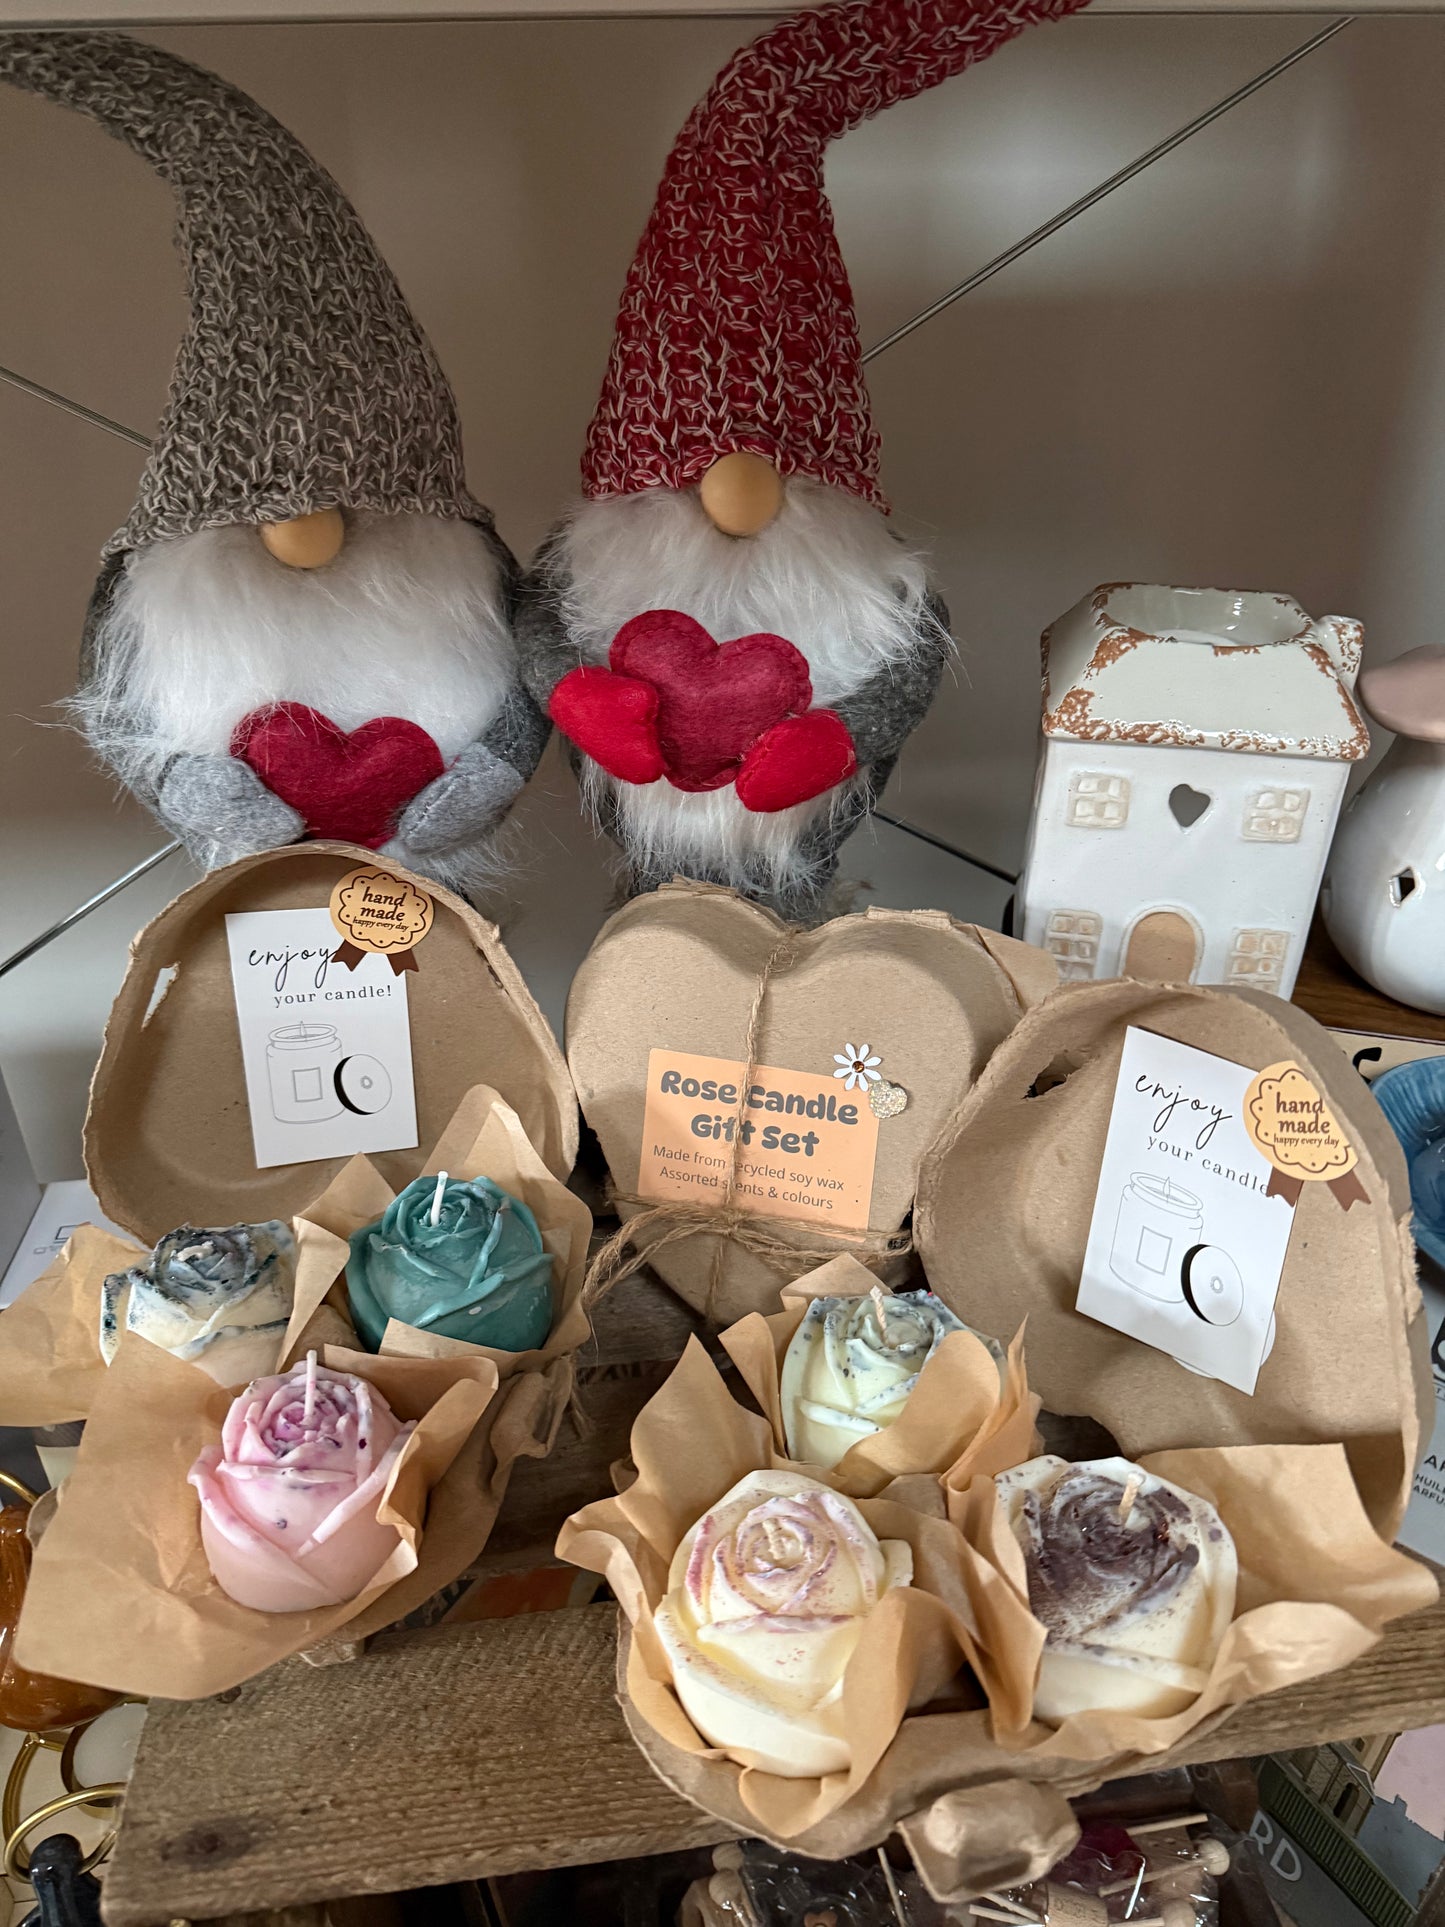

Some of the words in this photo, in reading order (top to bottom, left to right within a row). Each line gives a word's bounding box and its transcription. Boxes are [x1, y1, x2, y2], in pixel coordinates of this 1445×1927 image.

[360, 905, 406, 921] made
[362, 886, 407, 907] hand
[353, 916, 376, 929] happy
[376, 922, 395, 931] every
[395, 922, 409, 933] day
[248, 945, 337, 992] enjoy
[274, 992, 317, 1009] your
[324, 985, 392, 1001] candle!
[660, 1070, 738, 1104] Rose
[1276, 1091, 1325, 1114] hand
[1135, 1074, 1233, 1151] enjoy
[1278, 1112, 1331, 1134] made
[690, 1113, 757, 1146] Gift
[761, 1125, 820, 1157] Set
[1273, 1133, 1300, 1148] happy
[1301, 1137, 1323, 1148] every
[1324, 1134, 1340, 1149] day
[653, 1144, 690, 1163] Made
[693, 1152, 727, 1170] from
[732, 1160, 786, 1181] ecycled
[789, 1171, 813, 1188] soy
[816, 1177, 845, 1192] wax
[1147, 1135, 1194, 1162] your
[1201, 1158, 1275, 1199] candle
[659, 1166, 719, 1188] Assorted
[721, 1179, 764, 1197] sents
[767, 1186, 779, 1199] &
[782, 1190, 834, 1210] colours
[1250, 1809, 1301, 1882] RD
